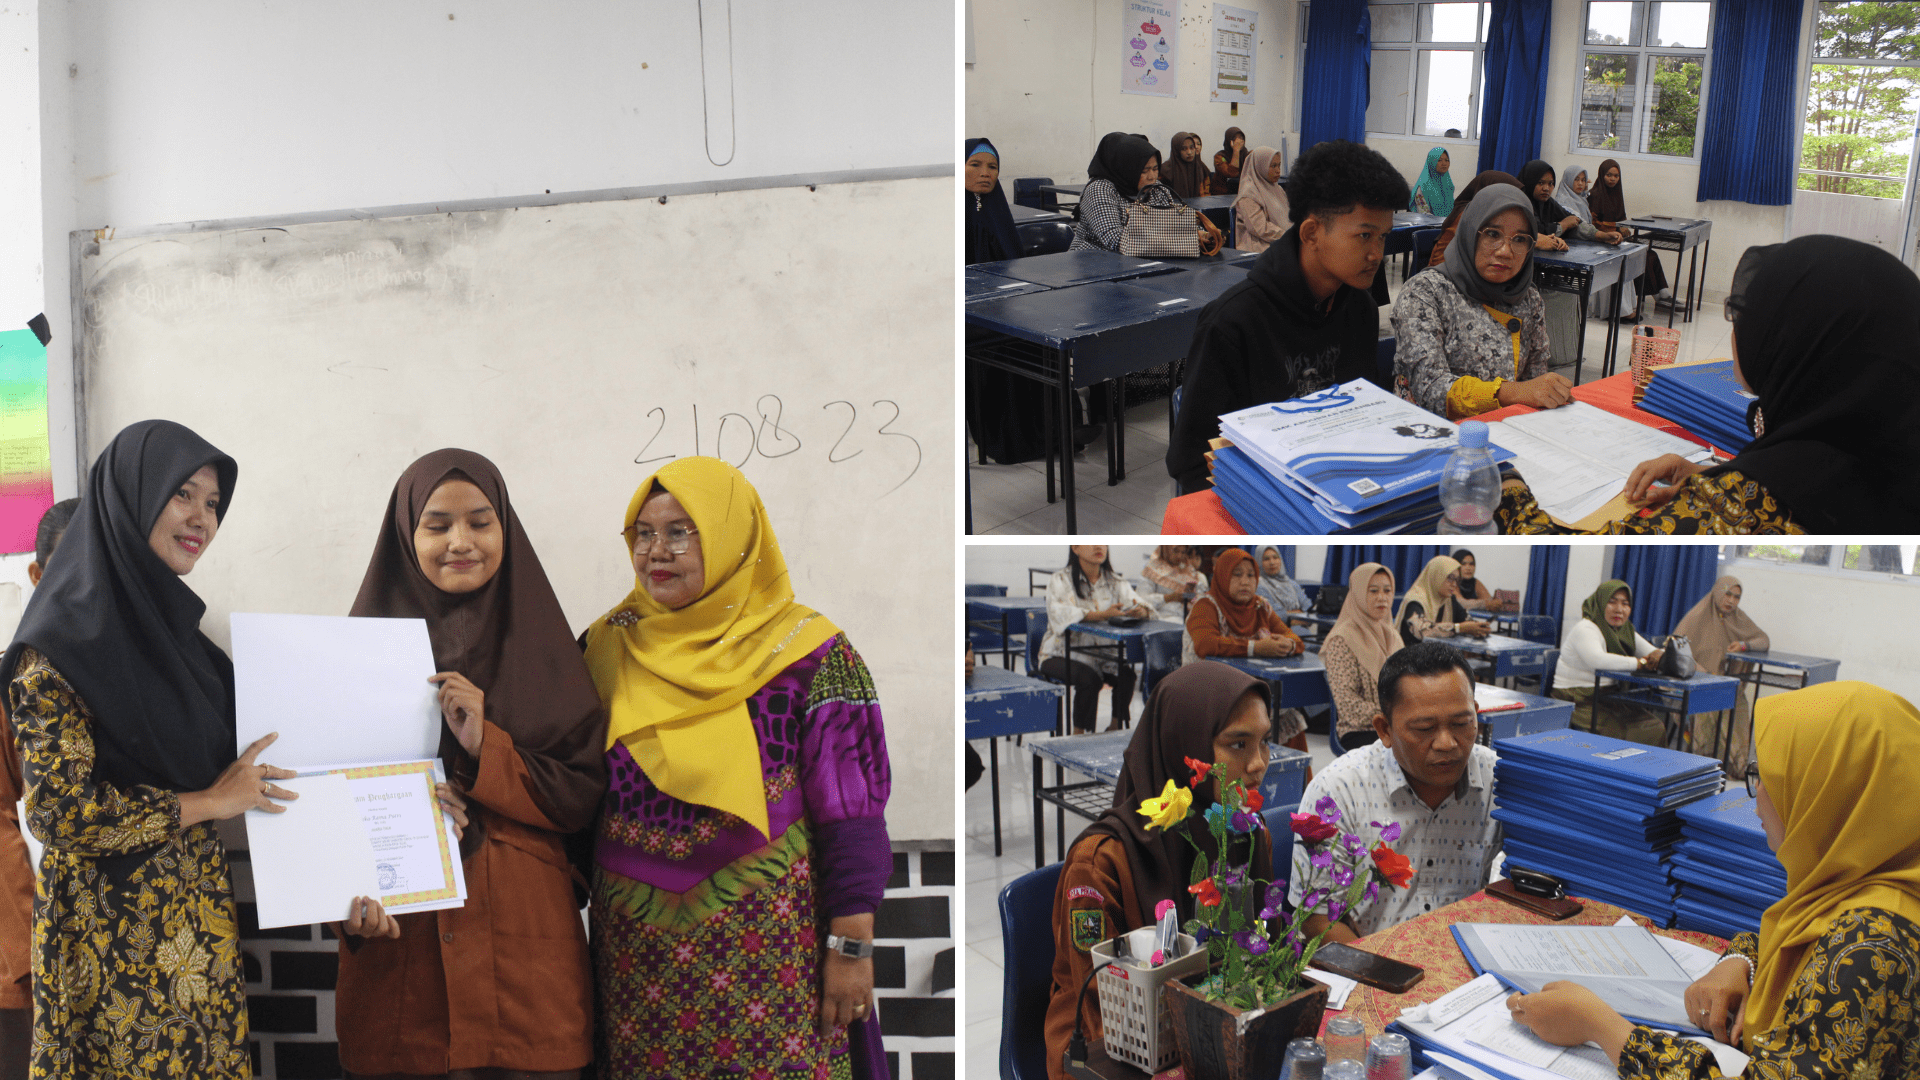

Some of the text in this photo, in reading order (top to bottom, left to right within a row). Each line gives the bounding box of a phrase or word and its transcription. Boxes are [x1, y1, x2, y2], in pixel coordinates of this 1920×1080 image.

[1131, 4, 1171, 17] STRUKTUR KELAS
[367, 791, 413, 803] Penghargaan
